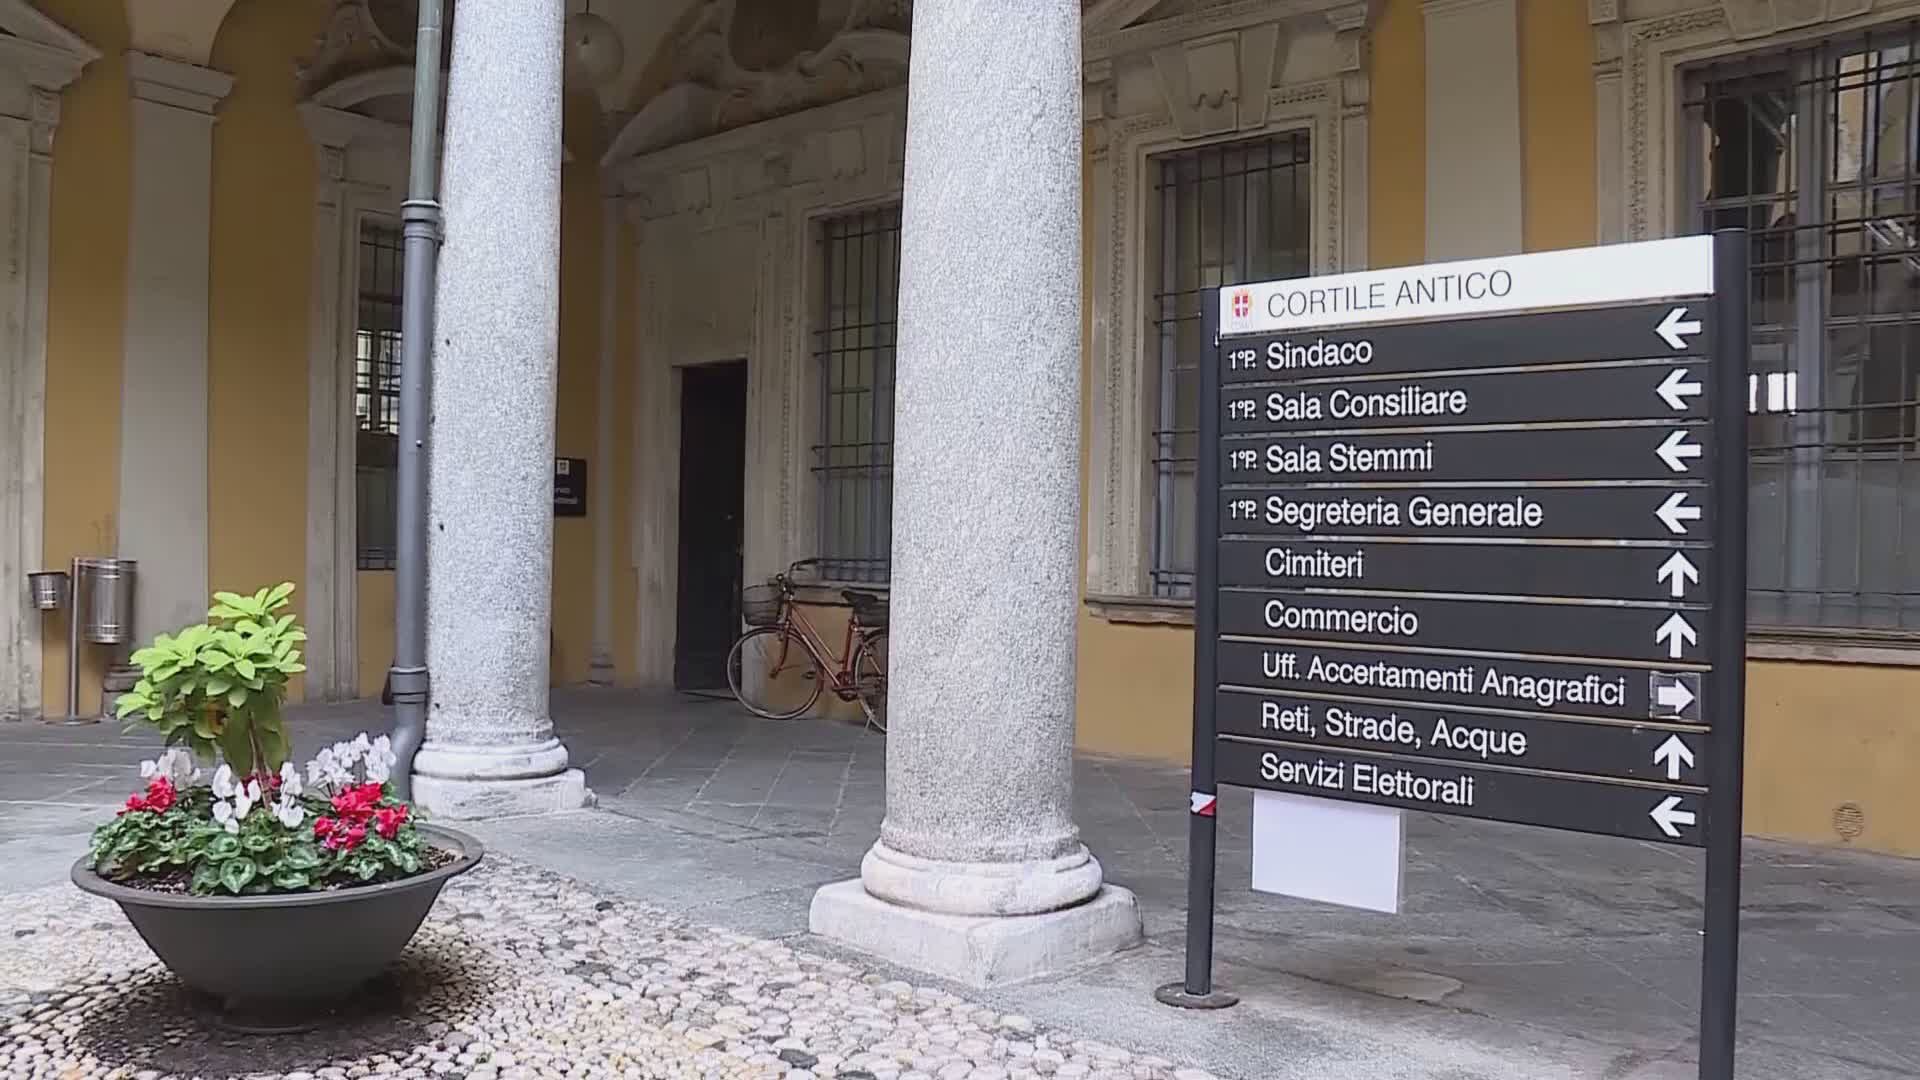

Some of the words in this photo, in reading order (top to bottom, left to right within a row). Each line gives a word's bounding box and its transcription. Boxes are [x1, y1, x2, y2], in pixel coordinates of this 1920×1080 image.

[1267, 282, 1386, 318] CORTILE
[1395, 269, 1513, 307] ANTICO
[1267, 339, 1372, 369] Sindaco
[1267, 392, 1322, 420] Sala
[1330, 386, 1467, 418] Consiliare
[1266, 445, 1322, 473] Sala
[1329, 441, 1432, 471] Stemmi
[1266, 496, 1400, 530] Segreteria
[1409, 496, 1542, 526] Generale
[1266, 548, 1362, 577] Cimiteri
[1264, 600, 1419, 636] Commercio
[1264, 652, 1300, 679] Uff.
[1306, 656, 1475, 694] Accertamenti
[1480, 669, 1626, 707] Anagrafici
[1262, 702, 1315, 737] Reti,
[1324, 708, 1422, 749] Strade,
[1430, 719, 1527, 758] Acque
[1260, 753, 1345, 789] Servizi
[1352, 764, 1475, 806] Elettorali
